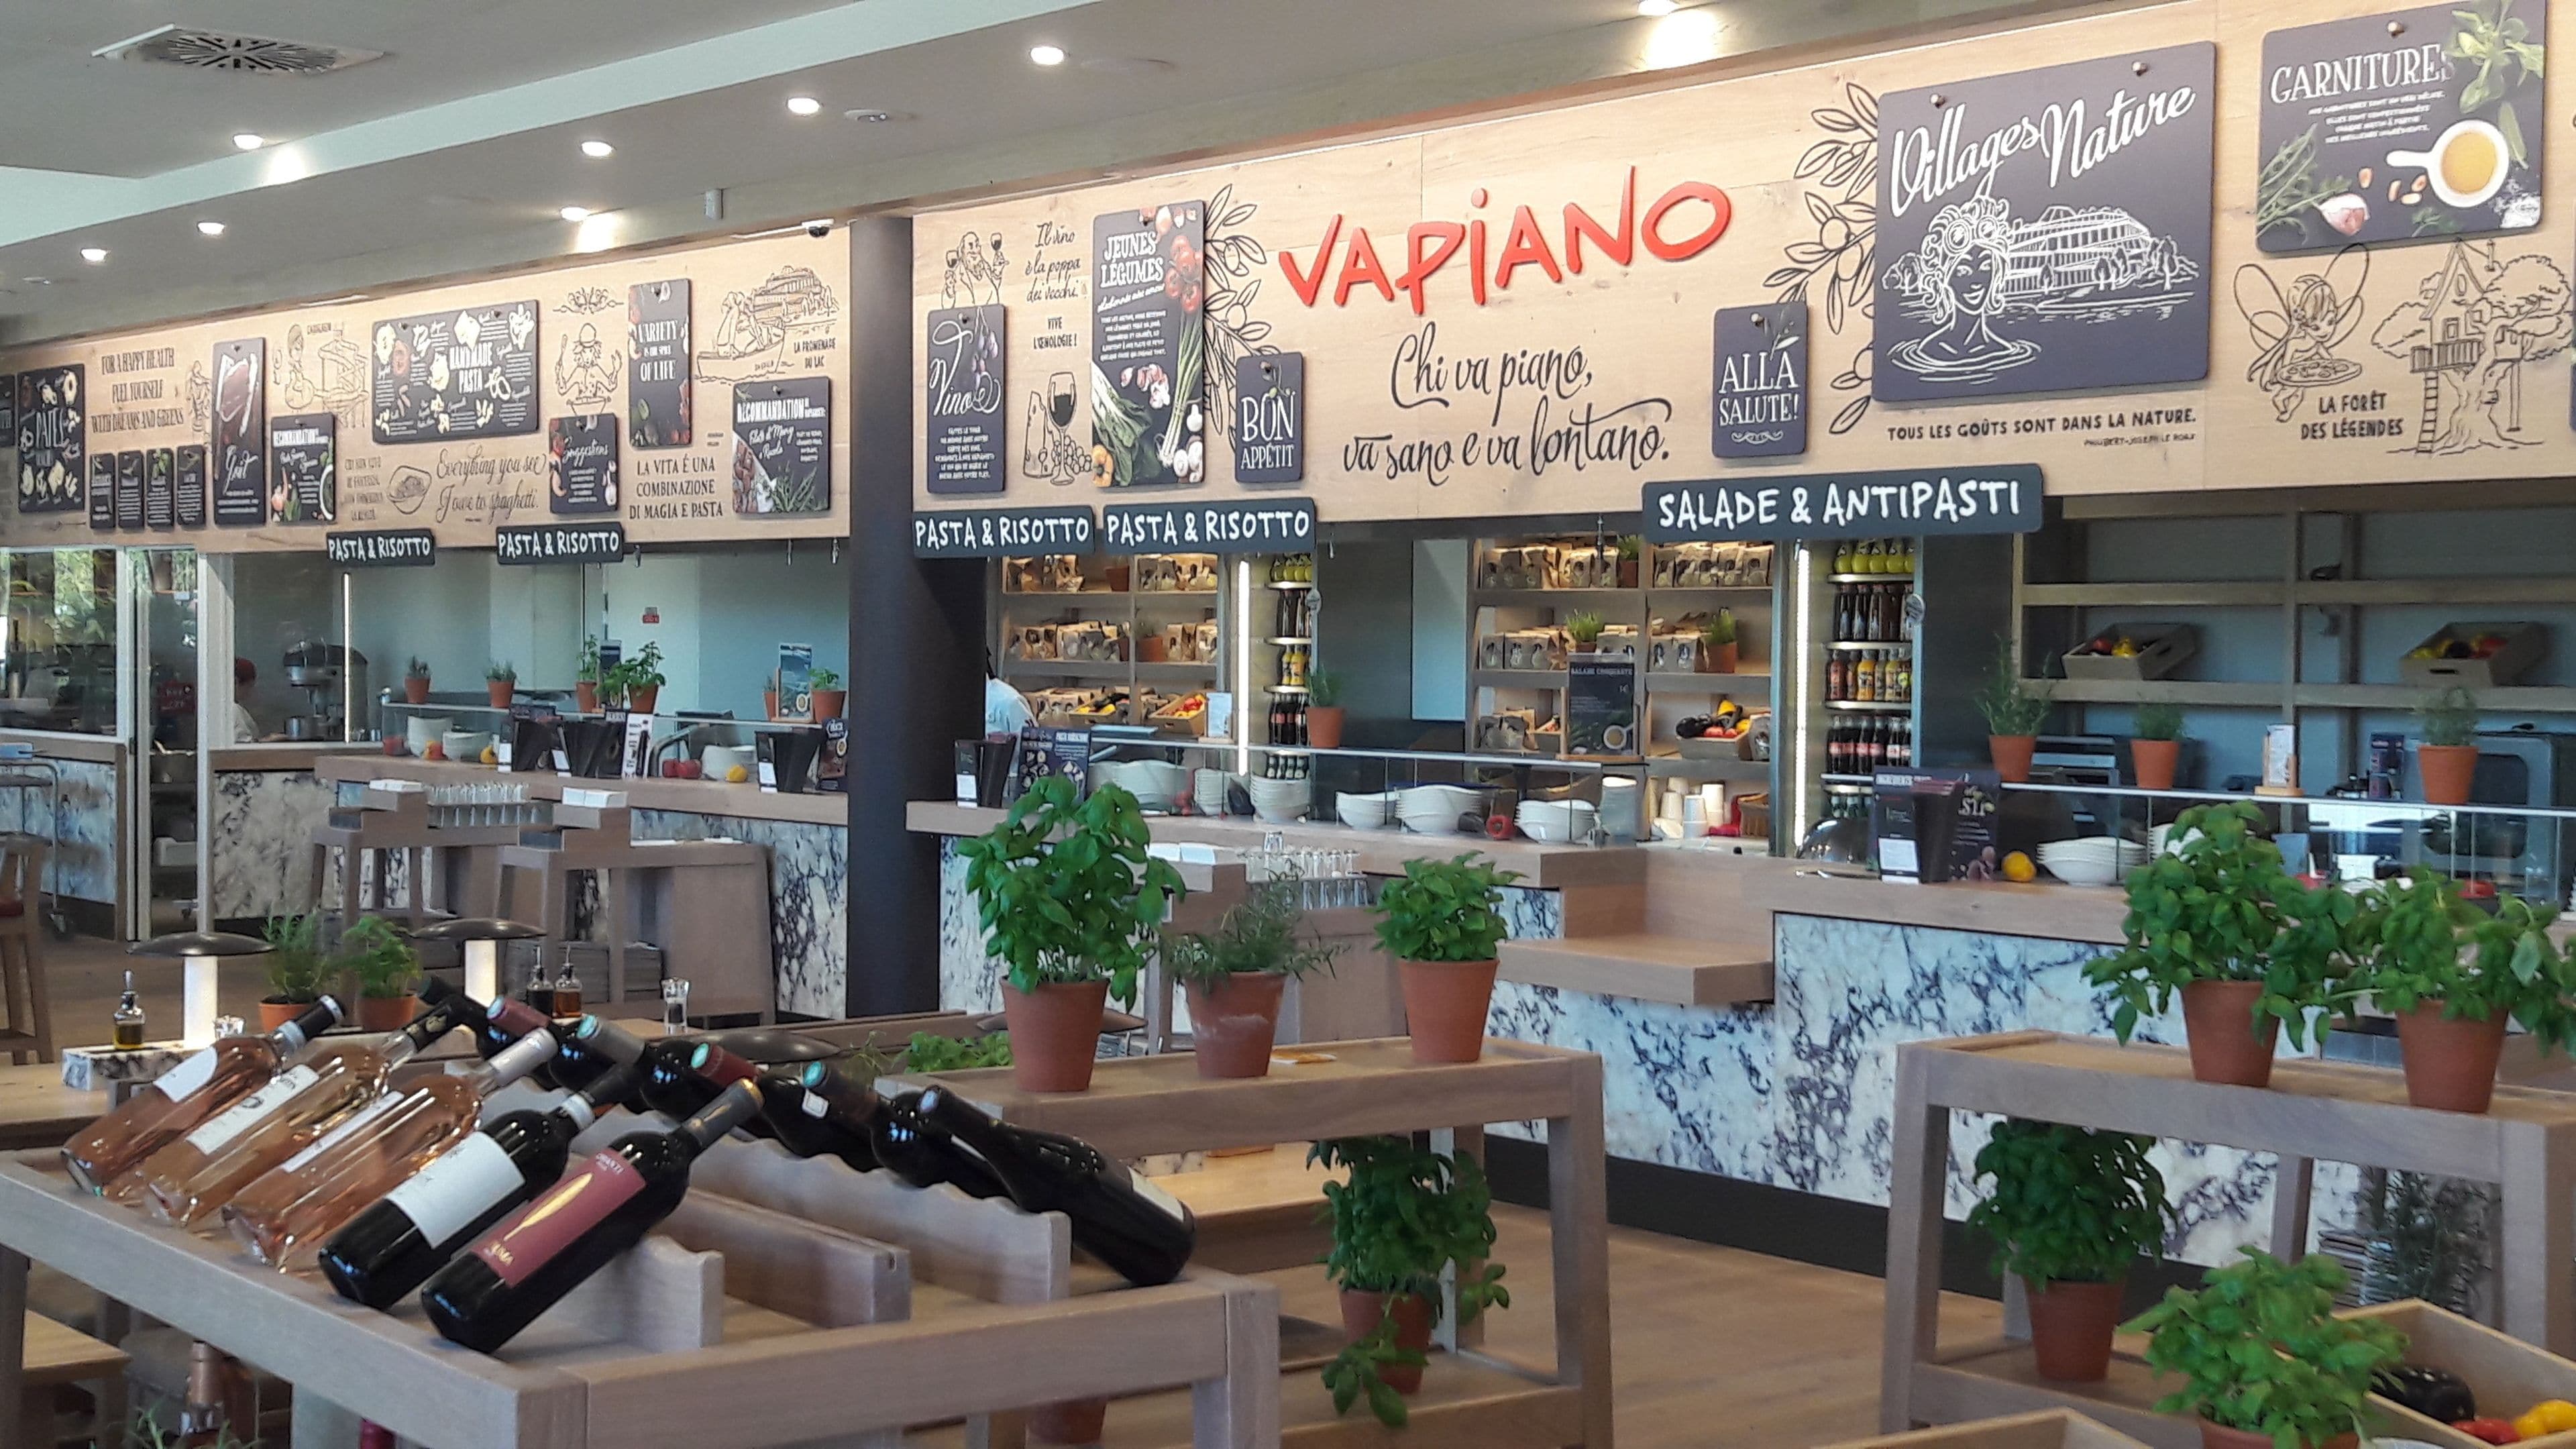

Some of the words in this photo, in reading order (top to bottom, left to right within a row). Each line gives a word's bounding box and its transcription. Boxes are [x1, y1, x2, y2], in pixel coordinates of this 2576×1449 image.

[1890, 103, 2040, 218] Villages
[2041, 87, 2196, 189] Nature
[1053, 225, 1075, 245] vino
[1104, 231, 1157, 261] JEUNES
[1278, 164, 1733, 315] VAPIANO
[1034, 250, 1046, 274] la
[1046, 258, 1081, 284] poppa
[1100, 256, 1164, 288] LÉGUMES
[638, 319, 678, 343] VARIETY
[1047, 317, 1063, 330] VIVE
[653, 360, 677, 381] LIFE
[929, 320, 1001, 416] Vino
[1391, 320, 1450, 409] Chi
[1454, 354, 1491, 396] va
[1491, 344, 1593, 428] piano,
[1718, 350, 1800, 394] ALLA
[1240, 390, 1296, 442] BON
[1719, 392, 1799, 428] SALUTE!
[2318, 396, 2337, 415] LA
[2341, 389, 2388, 413] FORÊT
[1887, 425, 1924, 442] TOUS
[1929, 424, 1952, 439] LES
[1957, 418, 2008, 437] GOÛTS
[2013, 417, 2057, 434] SONT
[2061, 414, 2103, 431] DANS
[2108, 412, 2126, 429] LA
[2131, 407, 2198, 428] NATURE.
[2301, 421, 2328, 440] DES
[2332, 417, 2405, 439] LÉGENDES
[1240, 441, 1295, 470] APPÉTIT
[1343, 434, 1394, 472] va
[1386, 439, 1456, 488] sano
[1462, 431, 1481, 467] e
[1486, 433, 1523, 471] va
[1529, 393, 1673, 476] lontano.
[498, 456, 521, 485] you
[637, 460, 650, 476] LA
[653, 458, 679, 475] VITA
[692, 456, 715, 472] UNA
[636, 478, 716, 498] COMBINAZIONE
[629, 504, 641, 519] DI
[644, 502, 678, 519] MAGIA
[681, 503, 688, 517] E
[691, 500, 723, 518] PASTA
[1658, 486, 1781, 532] SALADE
[1790, 486, 1813, 525] &
[1822, 476, 2021, 527] ANTIPASTI
[914, 519, 977, 550] PASTA
[981, 520, 995, 547] &
[999, 517, 1090, 547] RISOTTO
[1106, 511, 1179, 547] PASTA
[1184, 511, 1199, 543] &
[1205, 509, 1311, 545] RISOTTO
[327, 536, 367, 563] PASTA
[367, 537, 376, 559] &
[378, 536, 431, 559] RISOTTO
[497, 531, 542, 558] PASTA
[544, 534, 553, 557] &
[556, 530, 620, 556] RISOTTO
